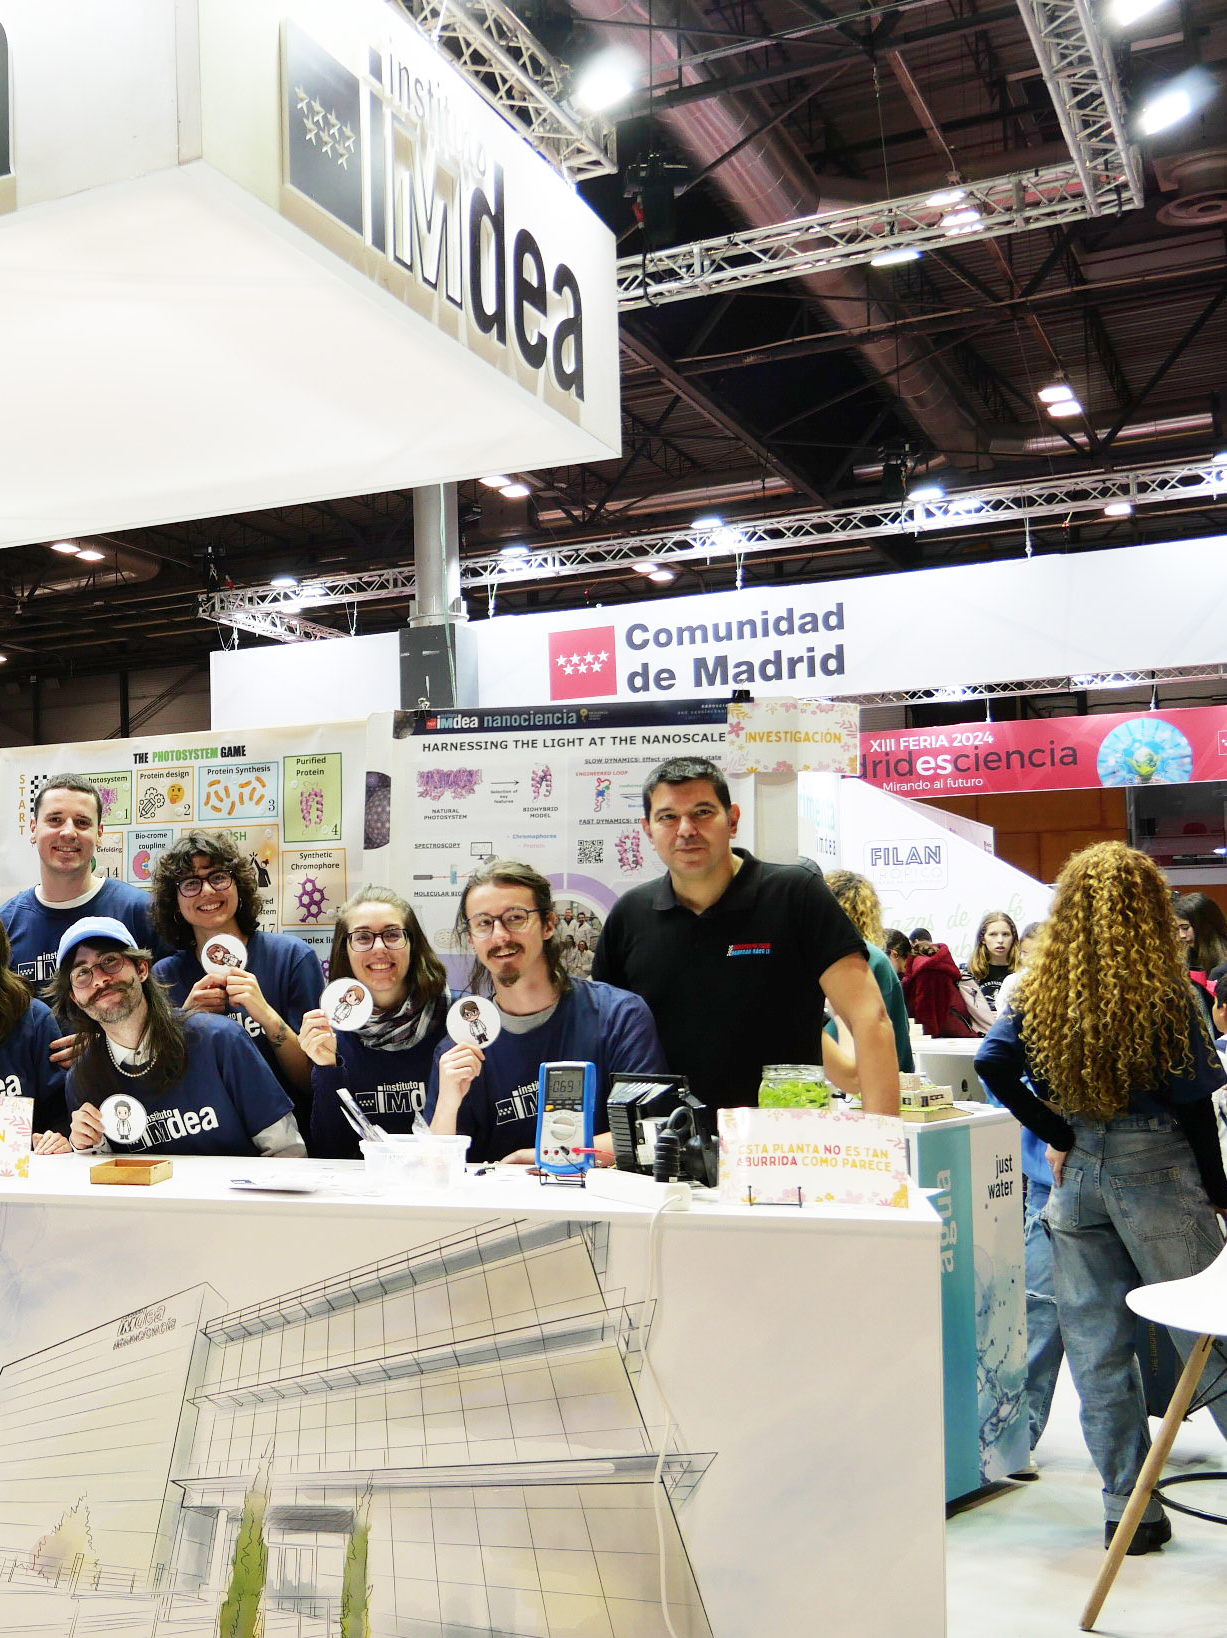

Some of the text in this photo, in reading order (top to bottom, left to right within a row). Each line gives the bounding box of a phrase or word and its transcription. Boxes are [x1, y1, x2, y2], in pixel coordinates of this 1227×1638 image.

[625, 602, 845, 650] Comunidad
[626, 644, 845, 693] de Madrid
[483, 709, 577, 728] nanociencia
[422, 732, 726, 752] HARNESSING THE LIGHT AT THE NANOSCALE
[745, 727, 842, 744] INVESTIGACIÓN
[869, 731, 994, 753] XIII FERIA 2024
[133, 745, 247, 764] THE PHOTOSYSTEM GAME
[296, 756, 327, 765] Purified
[139, 770, 190, 780] Protein design
[207, 765, 271, 776] Protein Synthesis
[88, 775, 128, 784] hotosystem
[882, 777, 983, 792] Mirando al futuro
[184, 803, 191, 816] 2
[268, 799, 276, 811] 3
[124, 808, 128, 819] 1
[135, 832, 168, 840] Bio-crome
[331, 824, 338, 836] 4
[138, 842, 166, 850] coupling
[299, 851, 333, 860] Synthetic
[870, 845, 942, 866] FILAN
[106, 867, 119, 878] 14
[290, 862, 340, 871] Chromophore
[382, 1080, 419, 1092] instituto
[773, 1144, 820, 1154] PLANTA
[823, 1145, 841, 1155] NO
[846, 1146, 860, 1157] ES
[865, 1147, 889, 1159] TAN
[736, 1156, 892, 1172] ABURRIDA COMO PARECE
[995, 1154, 1013, 1179] just
[987, 1180, 1014, 1199] water
[936, 1169, 958, 1273] agua
